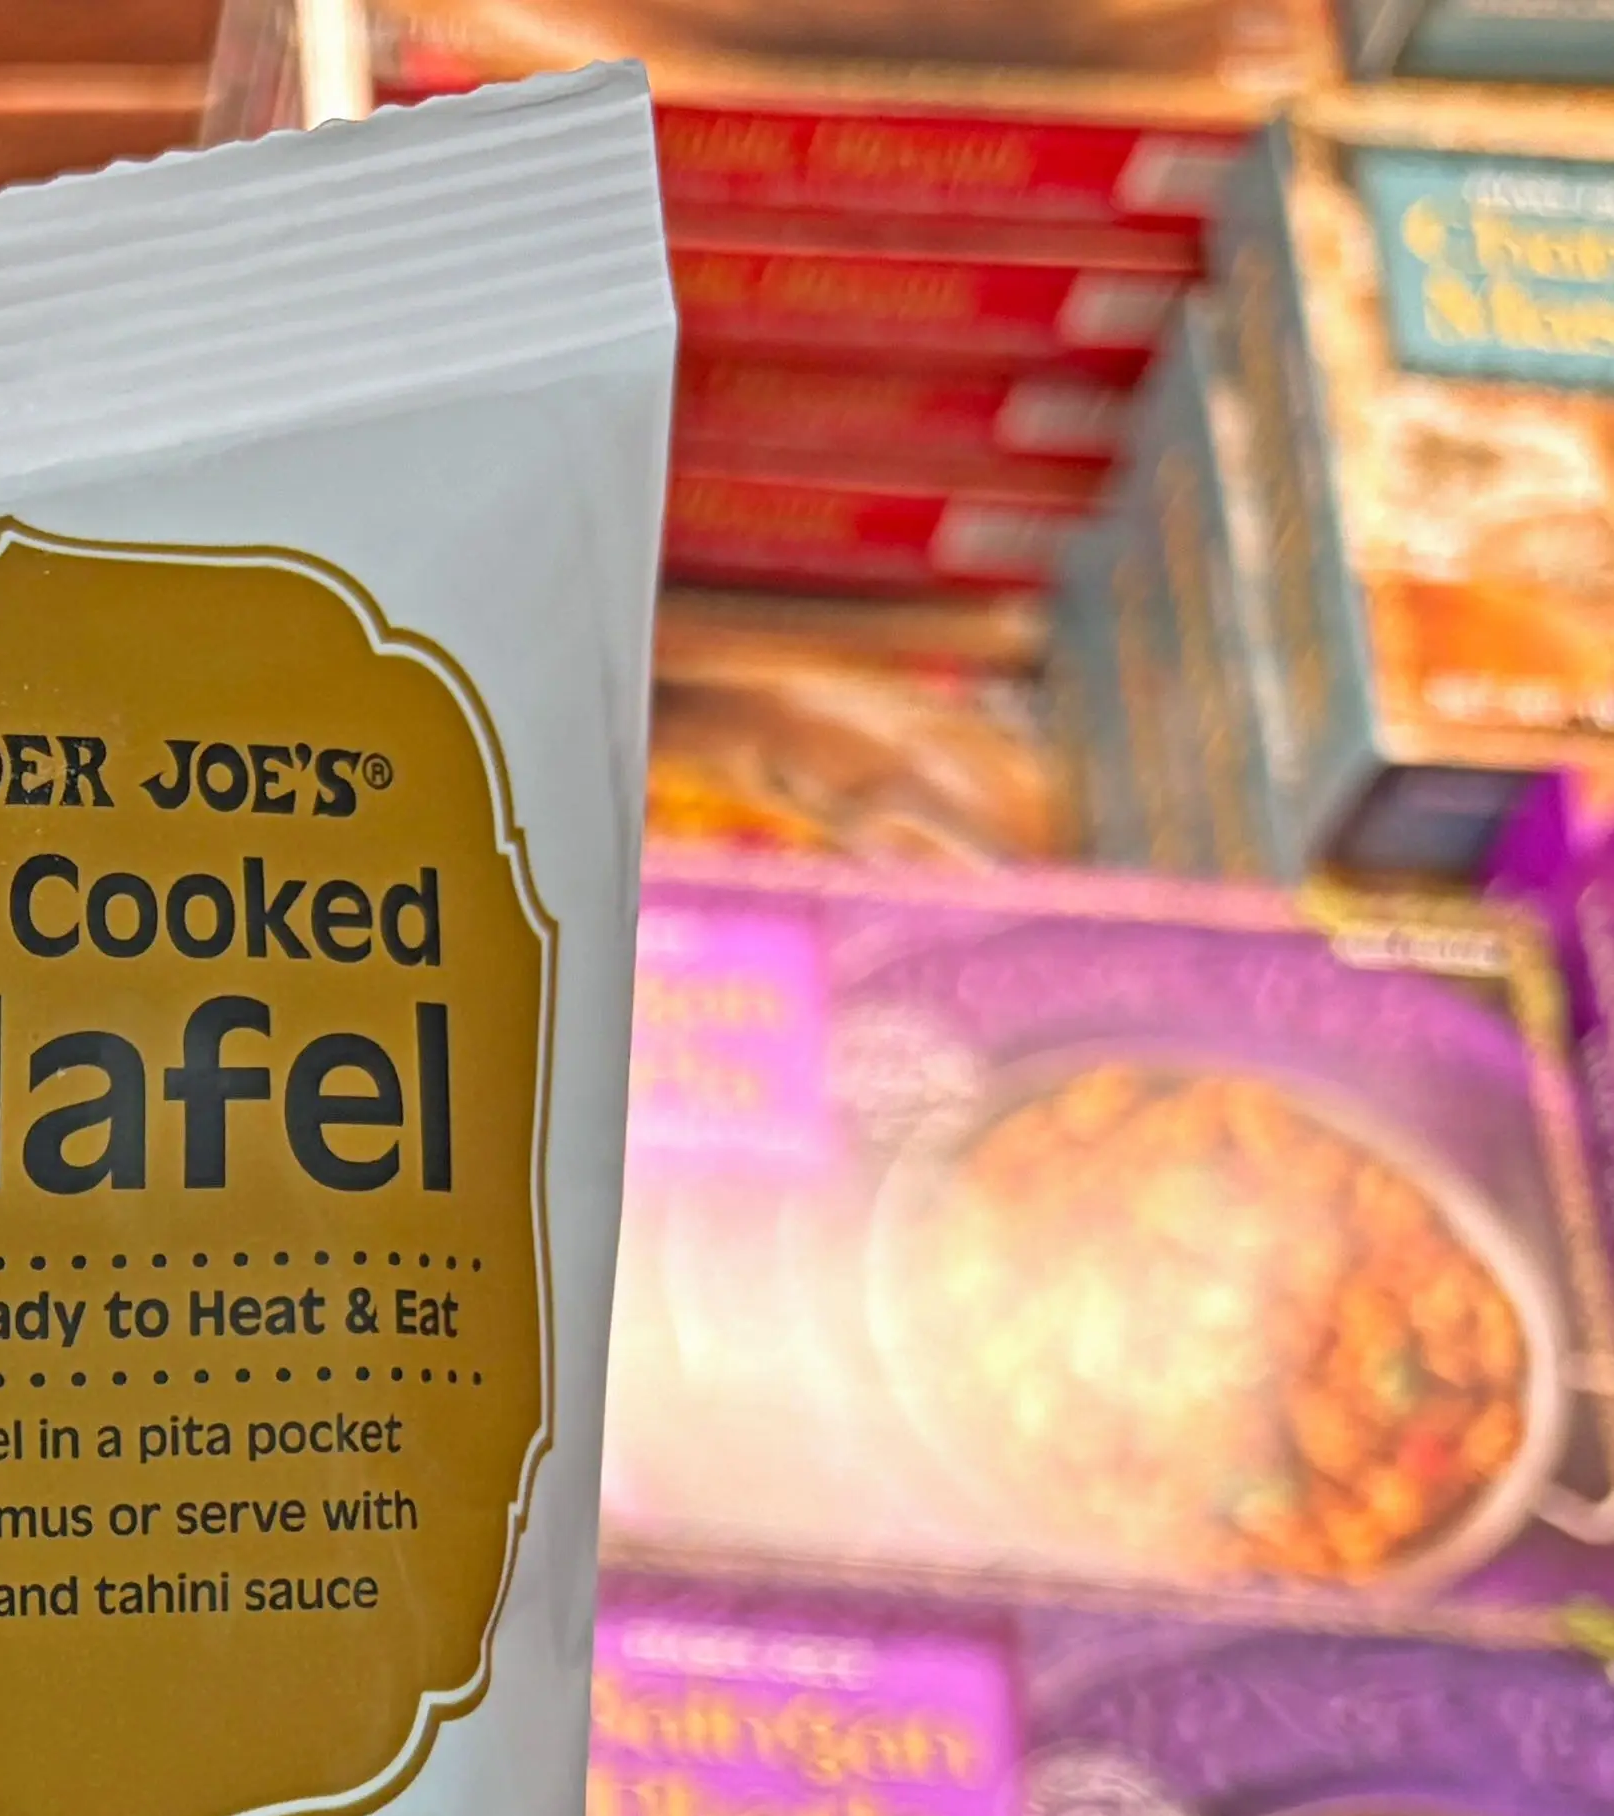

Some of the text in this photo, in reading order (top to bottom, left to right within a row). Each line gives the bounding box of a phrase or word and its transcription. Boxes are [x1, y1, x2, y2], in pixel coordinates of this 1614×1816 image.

[9, 853, 441, 967] Cooked
[103, 1291, 170, 1339] to
[189, 1287, 326, 1337] Heat
[345, 1286, 380, 1335] &
[395, 1288, 459, 1339] Eat
[39, 1417, 80, 1460] in
[97, 1425, 122, 1459] a
[139, 1415, 231, 1465] pita
[248, 1412, 403, 1462] pocket
[109, 1502, 162, 1536] or
[176, 1499, 307, 1535] serve
[322, 1489, 418, 1532] with
[93, 1571, 229, 1616] tahini
[244, 1576, 379, 1612] sauce
